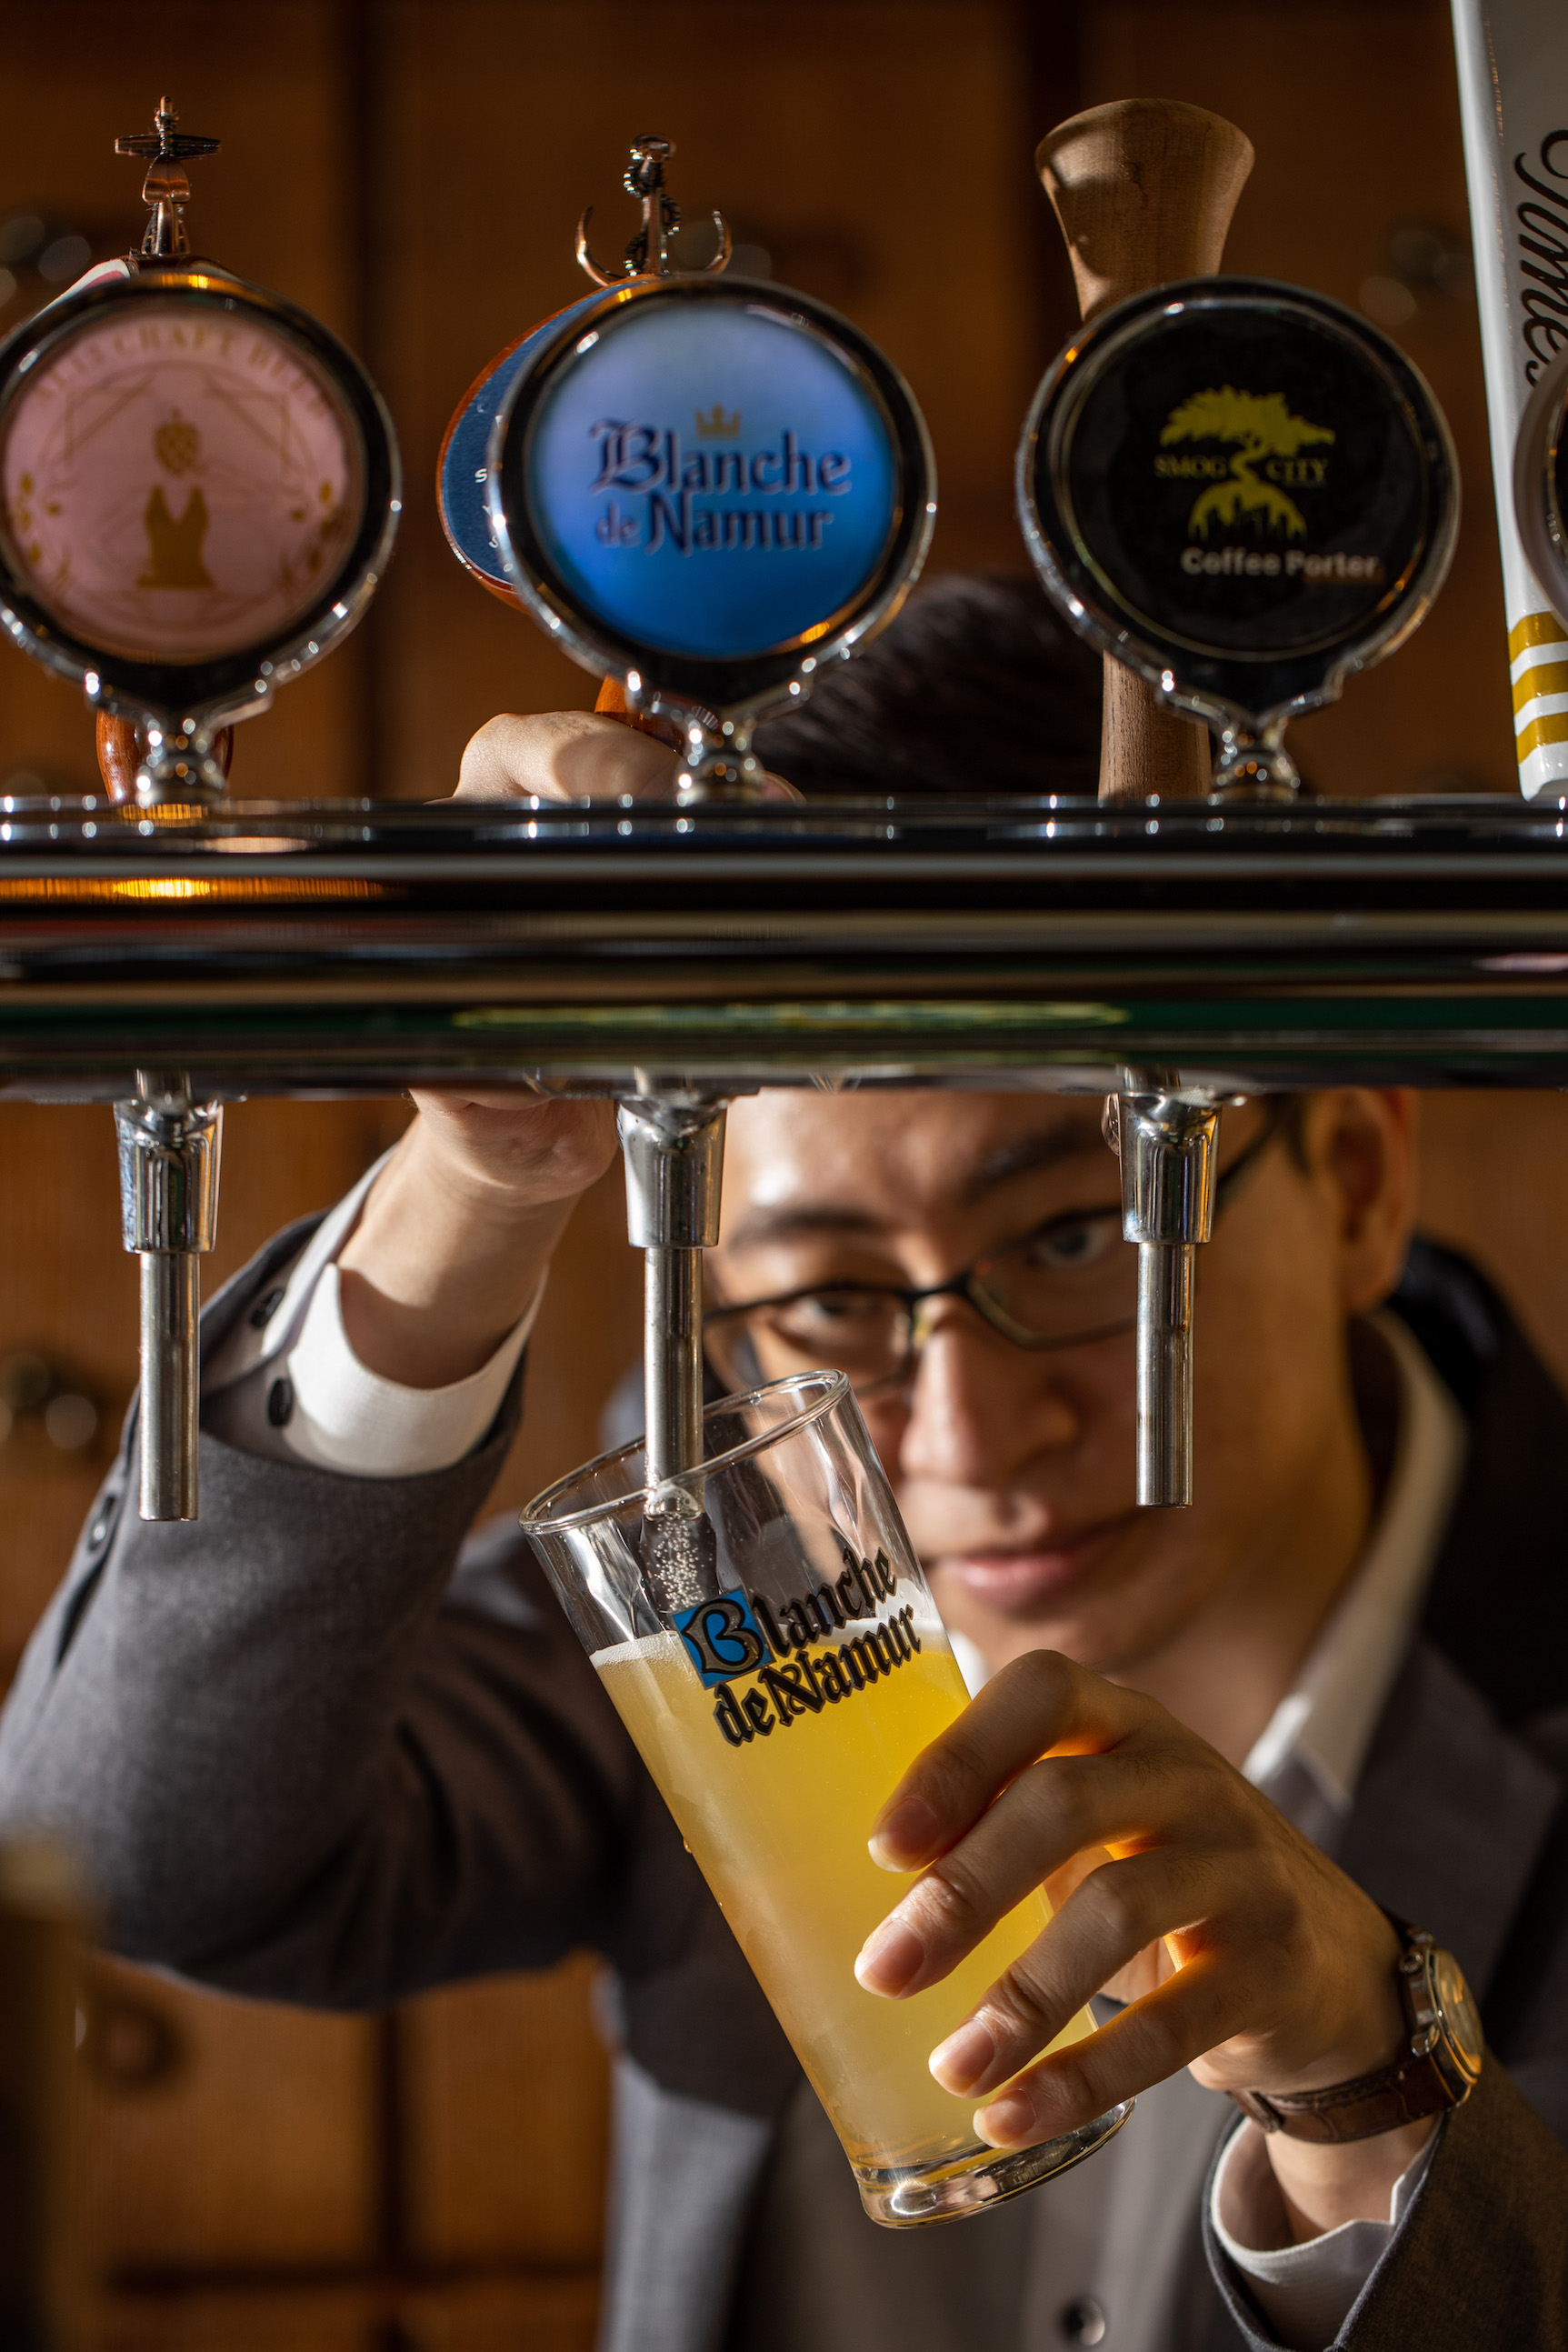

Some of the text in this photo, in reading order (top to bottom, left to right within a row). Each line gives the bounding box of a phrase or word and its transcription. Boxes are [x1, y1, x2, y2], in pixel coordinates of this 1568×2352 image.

[588, 417, 853, 496] Blanche
[1265, 456, 1328, 486] CITY
[596, 491, 834, 556] de Namur
[1181, 546, 1379, 578] Coffee Porter
[678, 1546, 897, 1678] Blanche
[713, 1604, 922, 1747] de Namur
